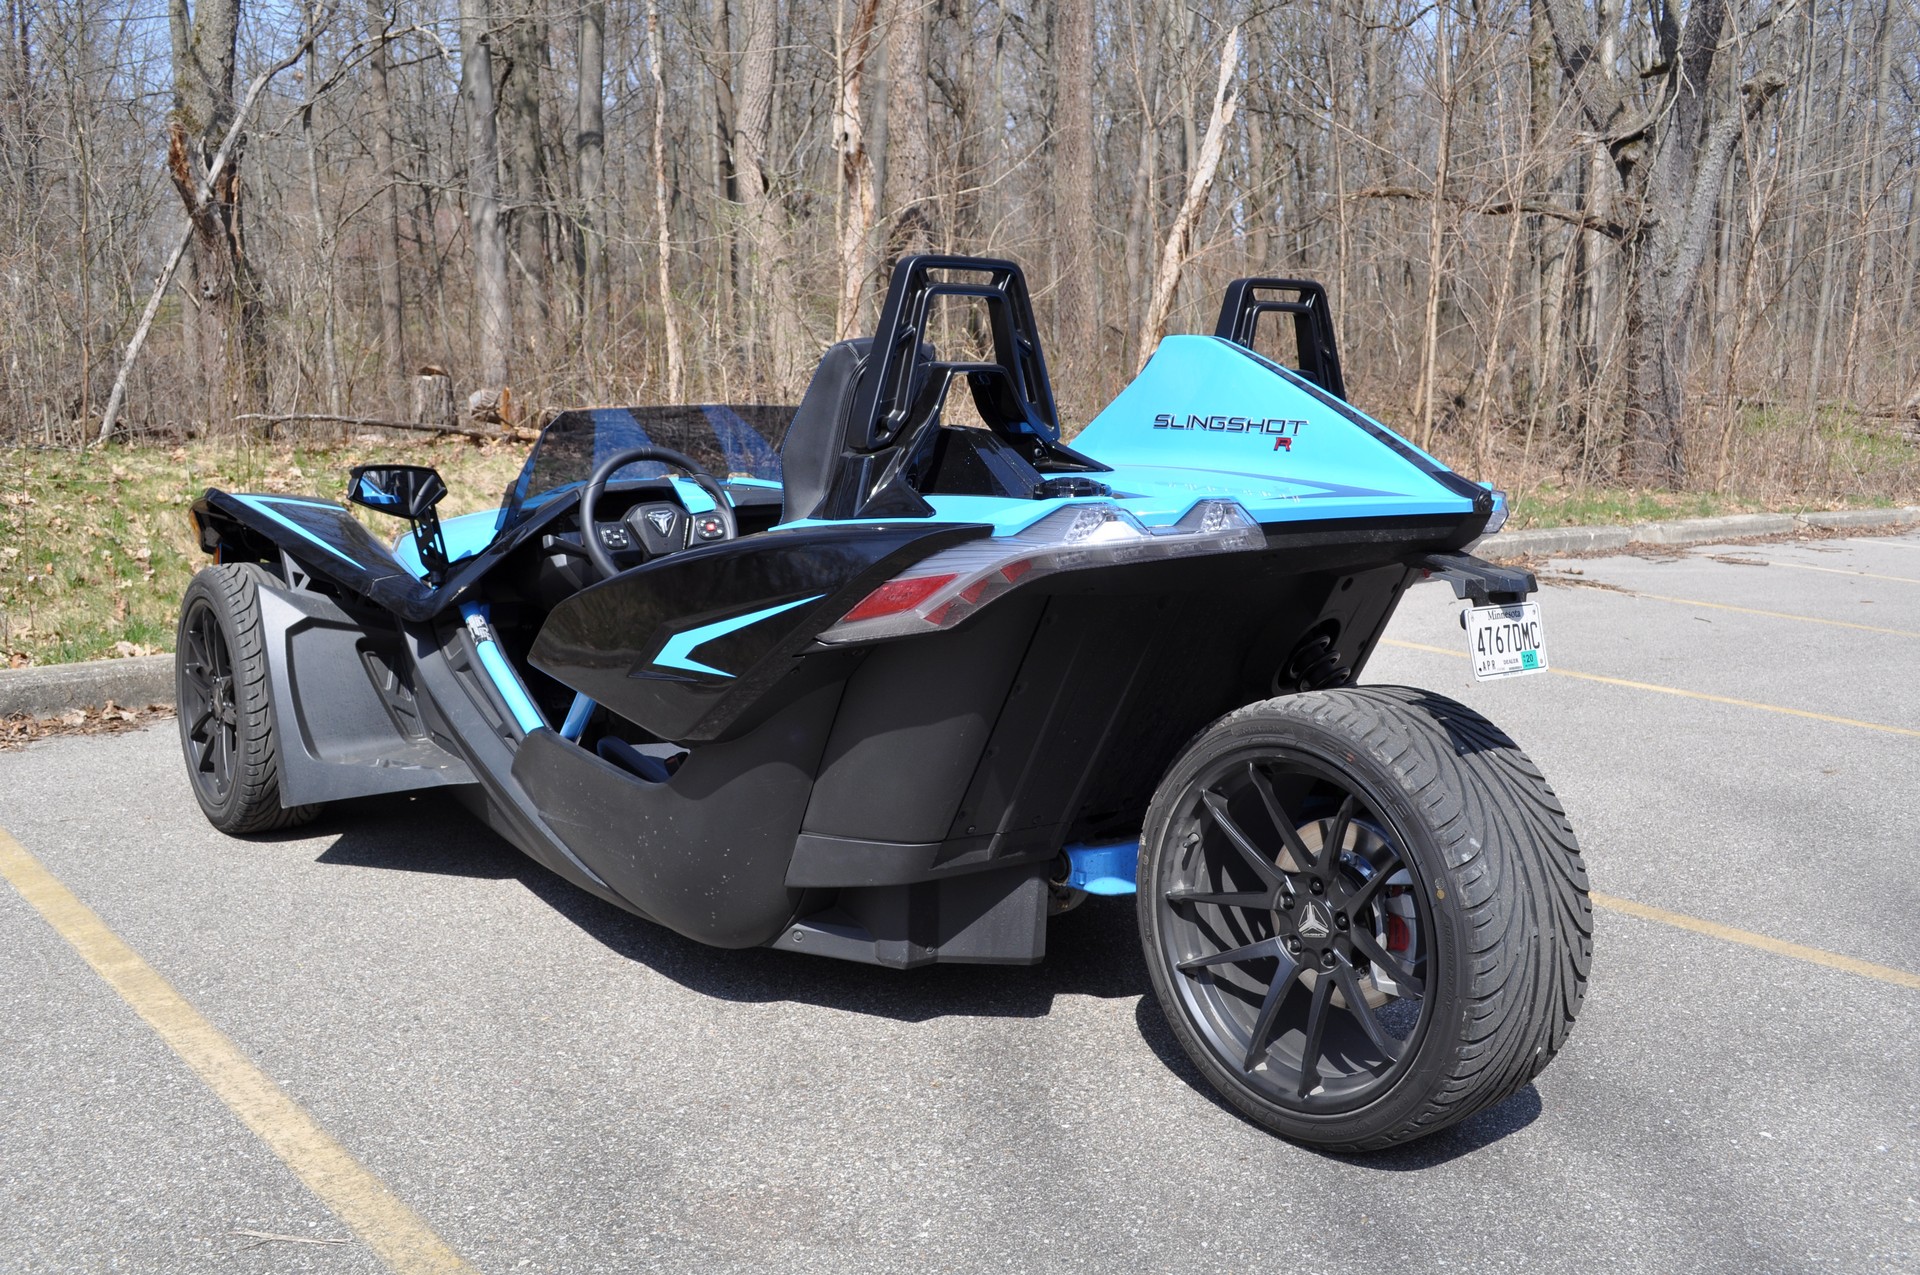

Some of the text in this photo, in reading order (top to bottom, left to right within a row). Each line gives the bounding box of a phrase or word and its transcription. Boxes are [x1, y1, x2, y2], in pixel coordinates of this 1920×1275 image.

[1153, 414, 1309, 436] SLINGSHOT
[1273, 437, 1293, 452] R
[1488, 610, 1521, 620] Minnesota
[1478, 621, 1540, 656] 4767DMC
[1482, 660, 1496, 671] APR
